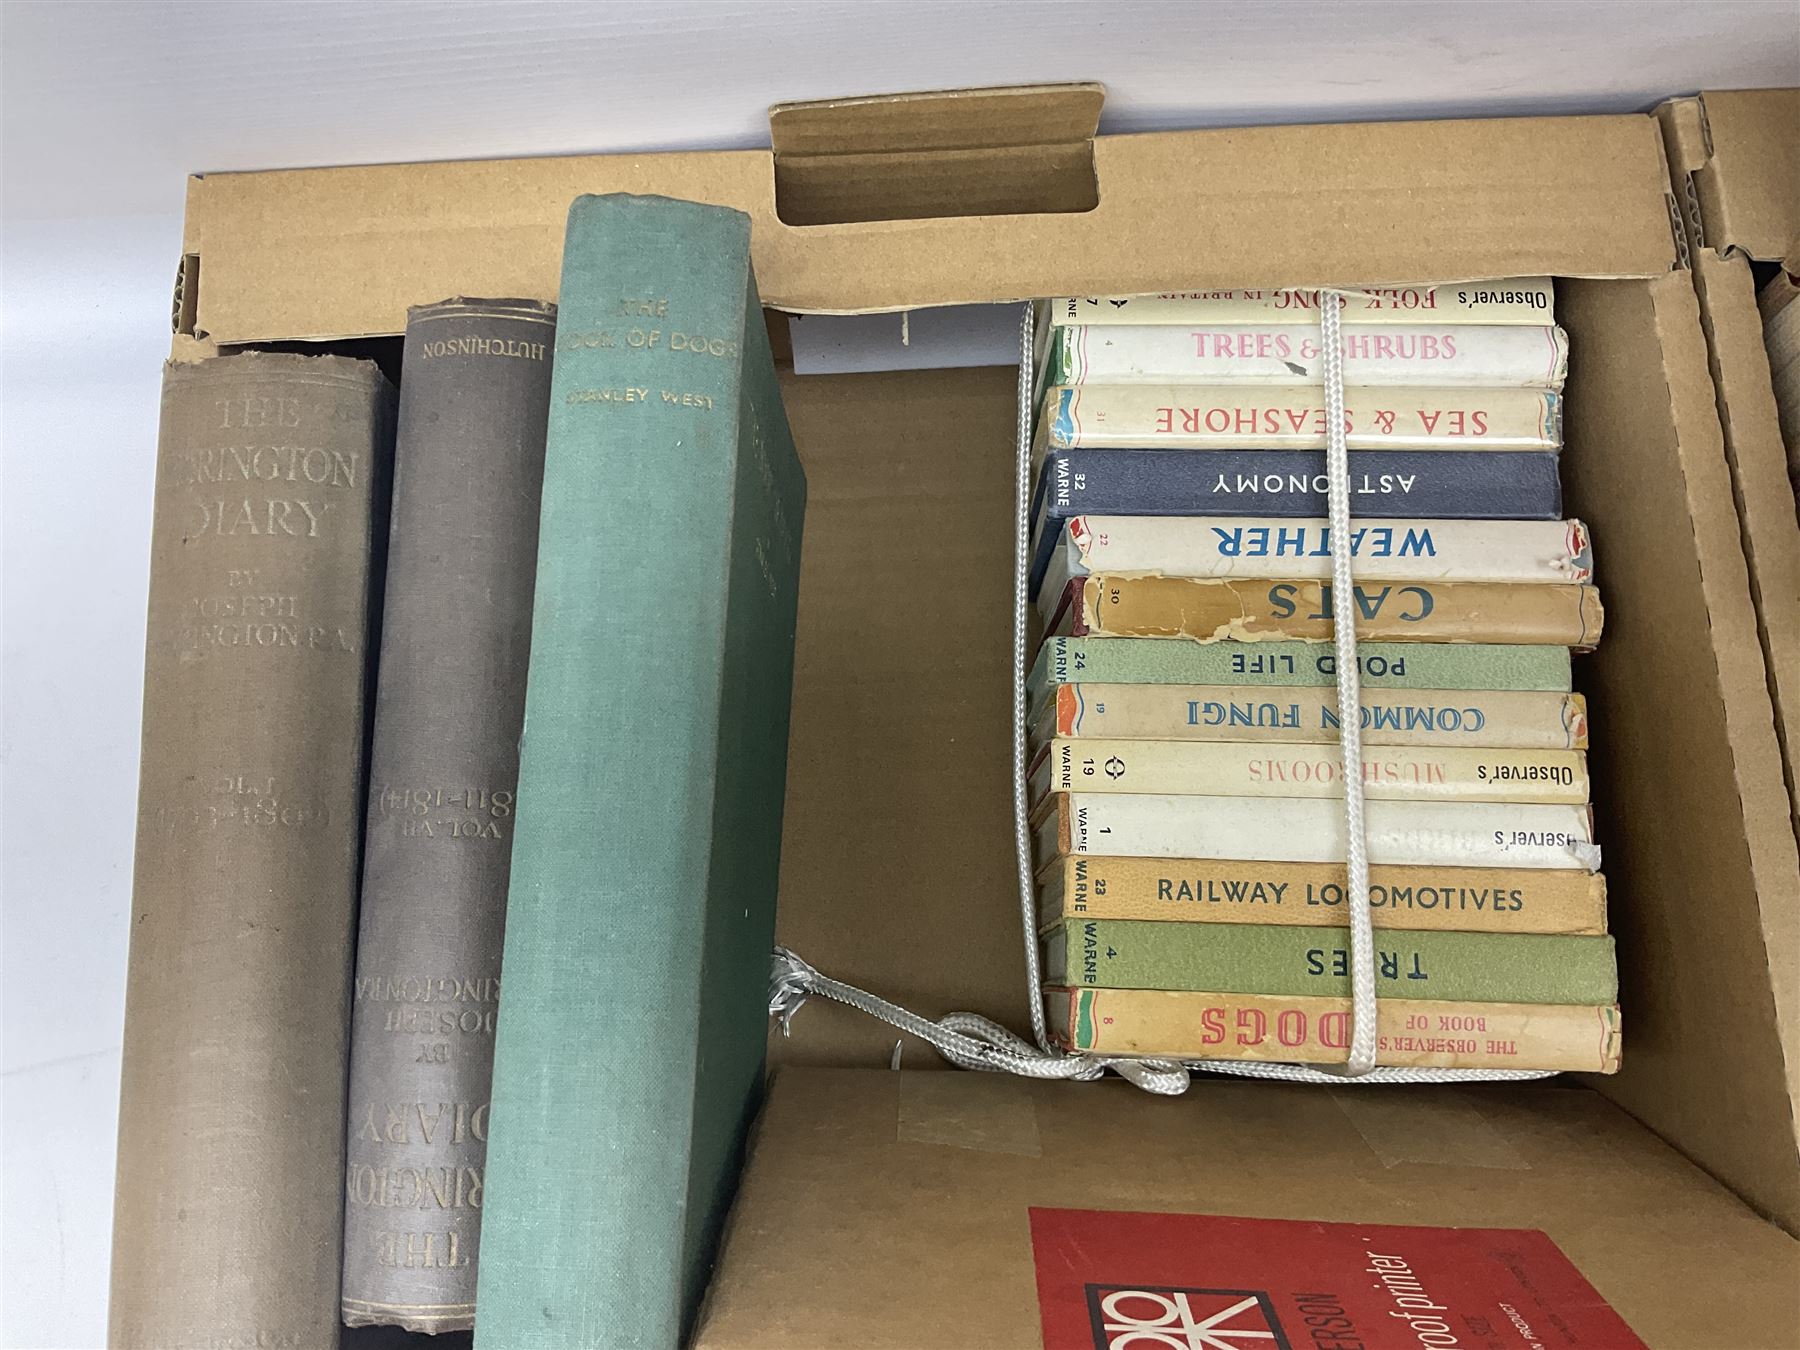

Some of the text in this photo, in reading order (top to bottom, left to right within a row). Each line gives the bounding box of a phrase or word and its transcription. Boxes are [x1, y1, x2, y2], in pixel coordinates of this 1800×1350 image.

[1458, 291, 1548, 309] Observer's
[627, 328, 661, 348] OF
[1190, 332, 1292, 360] TREES
[423, 340, 545, 361] HUTCHINSON
[215, 398, 302, 428] THE
[1374, 409, 1397, 435] &
[1417, 409, 1488, 436] SEA
[180, 446, 360, 488] RINGTON
[1057, 458, 1069, 508] WARNE
[1074, 473, 1086, 491] 32
[1212, 474, 1416, 494] ASTONOMY
[1099, 533, 1108, 546] 22
[1111, 588, 1120, 605] 30
[1268, 584, 1435, 622] CATS
[1074, 652, 1086, 671] 24
[1232, 654, 1294, 674] LIFE
[1095, 702, 1105, 714] 19
[1186, 701, 1301, 729] FUNGI
[1062, 745, 1071, 789] WARNE
[1082, 758, 1095, 776] 19
[1478, 764, 1573, 786] Observer's
[1100, 826, 1111, 835] 1
[1494, 830, 1577, 852] server's
[1074, 860, 1087, 912] WARNE
[1095, 879, 1106, 896] 23
[1157, 878, 1523, 911] RAILWAY LOOMOTIVES
[1084, 922, 1097, 984] WARNE
[1105, 946, 1117, 960] 4
[1307, 949, 1428, 980] TRES
[1103, 1017, 1114, 1025] 8
[1201, 1006, 1351, 1048] DOGS
[1406, 1014, 1487, 1032] BOOK OF
[415, 1042, 450, 1063] BY
[1379, 1037, 1518, 1054] THE OBSERVER'S
[358, 1103, 491, 1144] DIARY
[348, 1165, 486, 1210] RINGTON
[377, 1231, 470, 1268] THE
[1366, 1251, 1447, 1310] printer
[1499, 1302, 1537, 1340] PRODUCT
